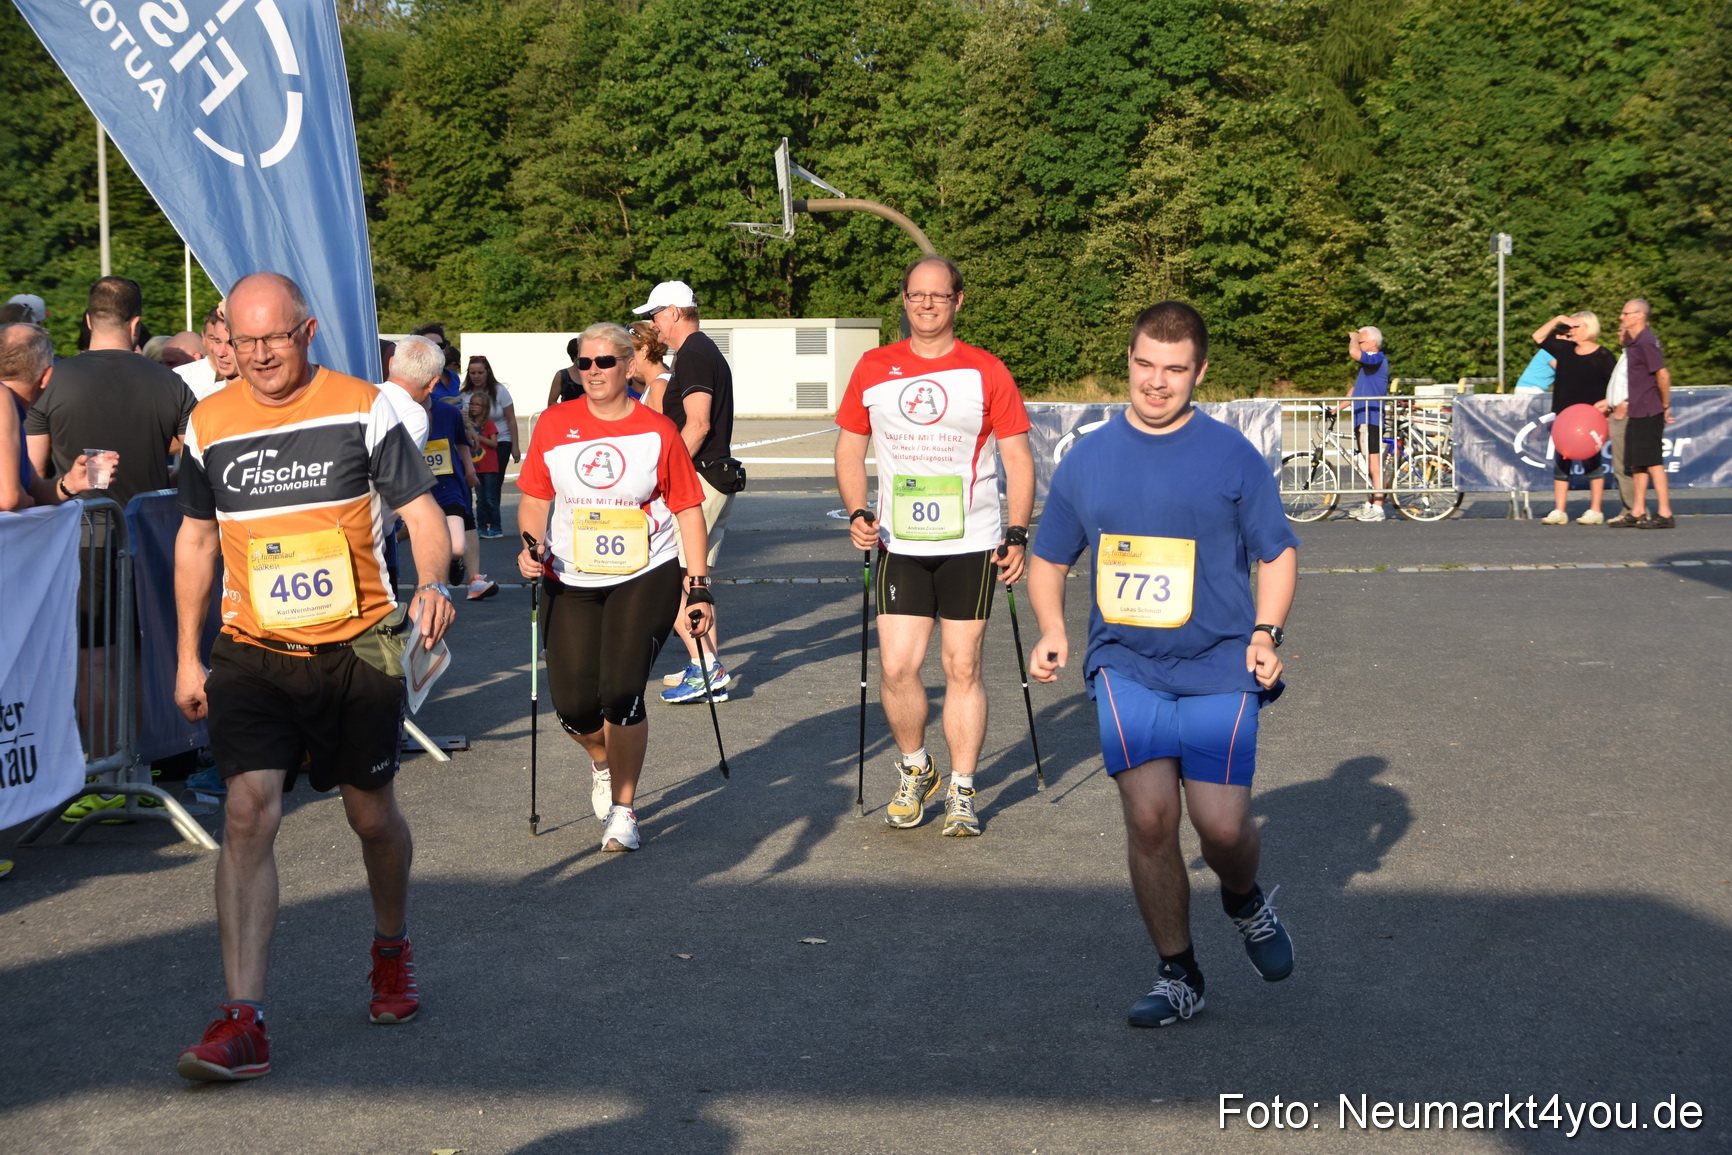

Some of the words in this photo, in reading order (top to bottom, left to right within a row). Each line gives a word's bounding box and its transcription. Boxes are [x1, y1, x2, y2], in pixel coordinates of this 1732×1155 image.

[884, 432, 915, 441] LAUFEN
[938, 433, 963, 442] HERZ
[424, 454, 443, 466] 99
[241, 460, 333, 487] Fischer
[250, 478, 327, 495] AUTOMOBILE
[912, 502, 940, 522] 80
[596, 535, 625, 555] 86
[270, 569, 333, 602] 466
[1115, 572, 1171, 602] 773
[277, 607, 289, 616] Karl
